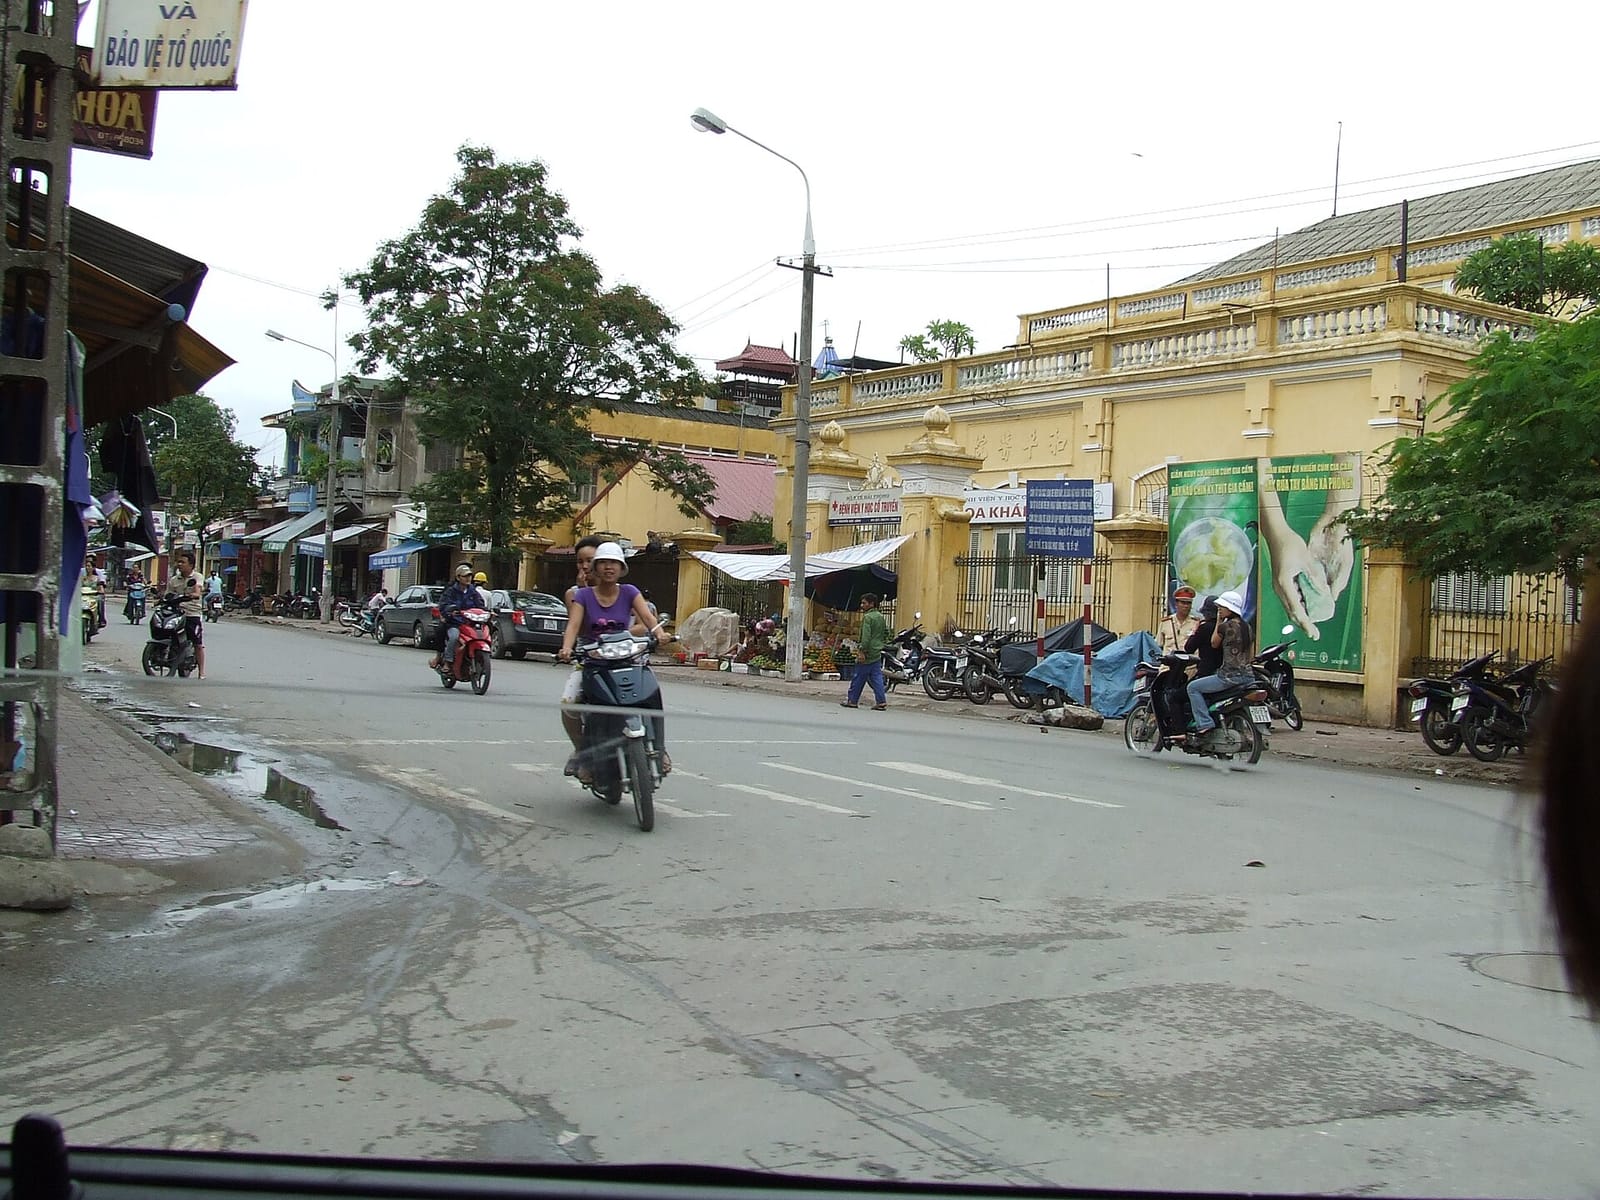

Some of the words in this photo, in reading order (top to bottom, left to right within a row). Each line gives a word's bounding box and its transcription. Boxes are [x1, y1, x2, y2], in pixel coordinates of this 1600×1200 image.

[159, 1, 197, 20] VÀ
[105, 29, 139, 67] BẢO
[144, 33, 164, 73] VỆ
[167, 28, 191, 68] TỔ
[190, 30, 232, 71] QUỐC
[74, 91, 145, 132] HOA
